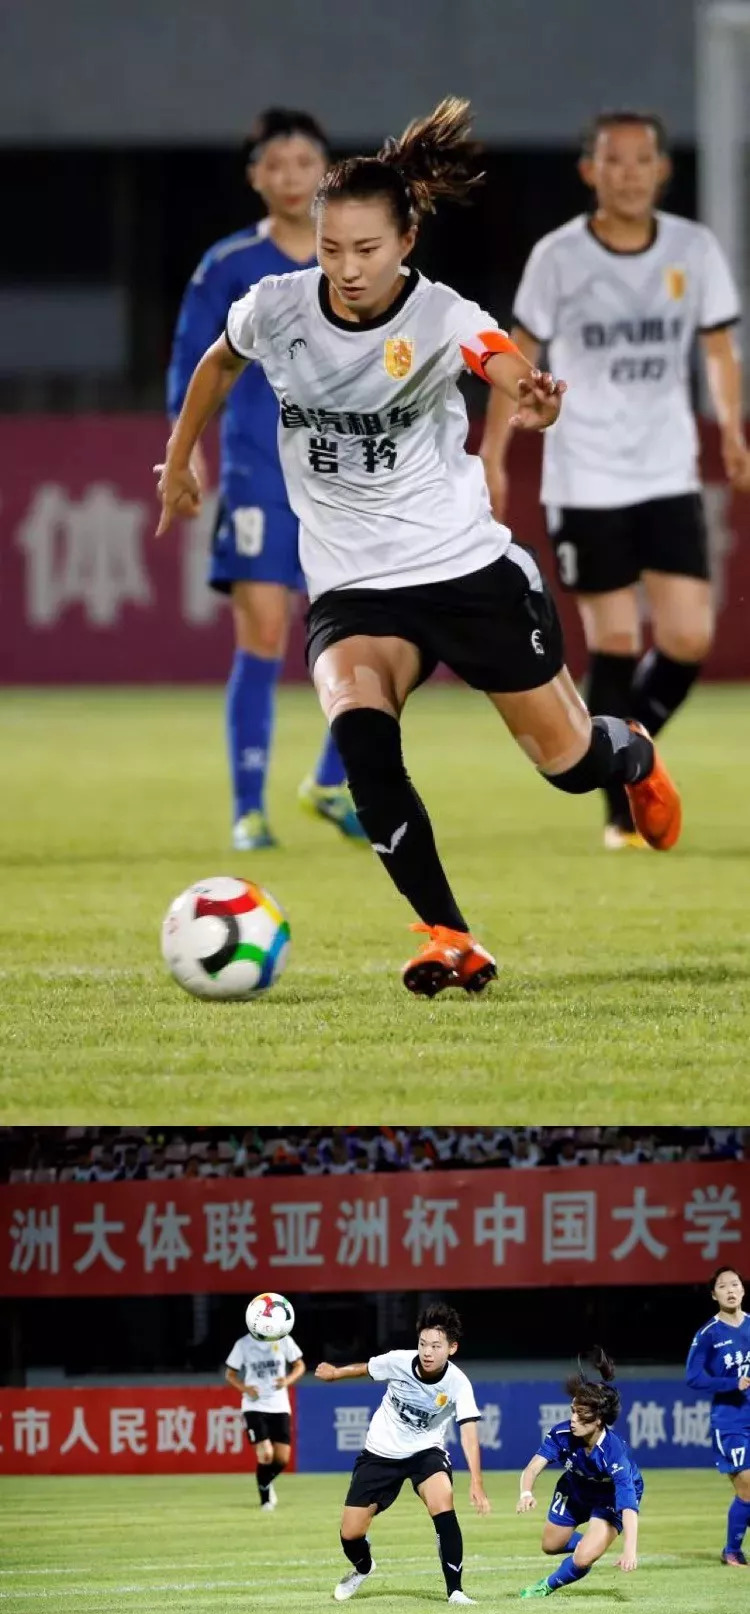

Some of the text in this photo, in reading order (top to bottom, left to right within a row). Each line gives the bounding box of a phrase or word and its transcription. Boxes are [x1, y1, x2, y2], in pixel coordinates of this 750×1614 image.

[281, 397, 420, 436] 首汽租车
[308, 436, 398, 474] 岩羚
[8, 1185, 742, 1275] 洲大体联亚洲杯中国大学
[0, 1405, 247, 1455] 市人民政府
[730, 1447, 746, 1468] 17
[551, 1491, 569, 1517] 21
